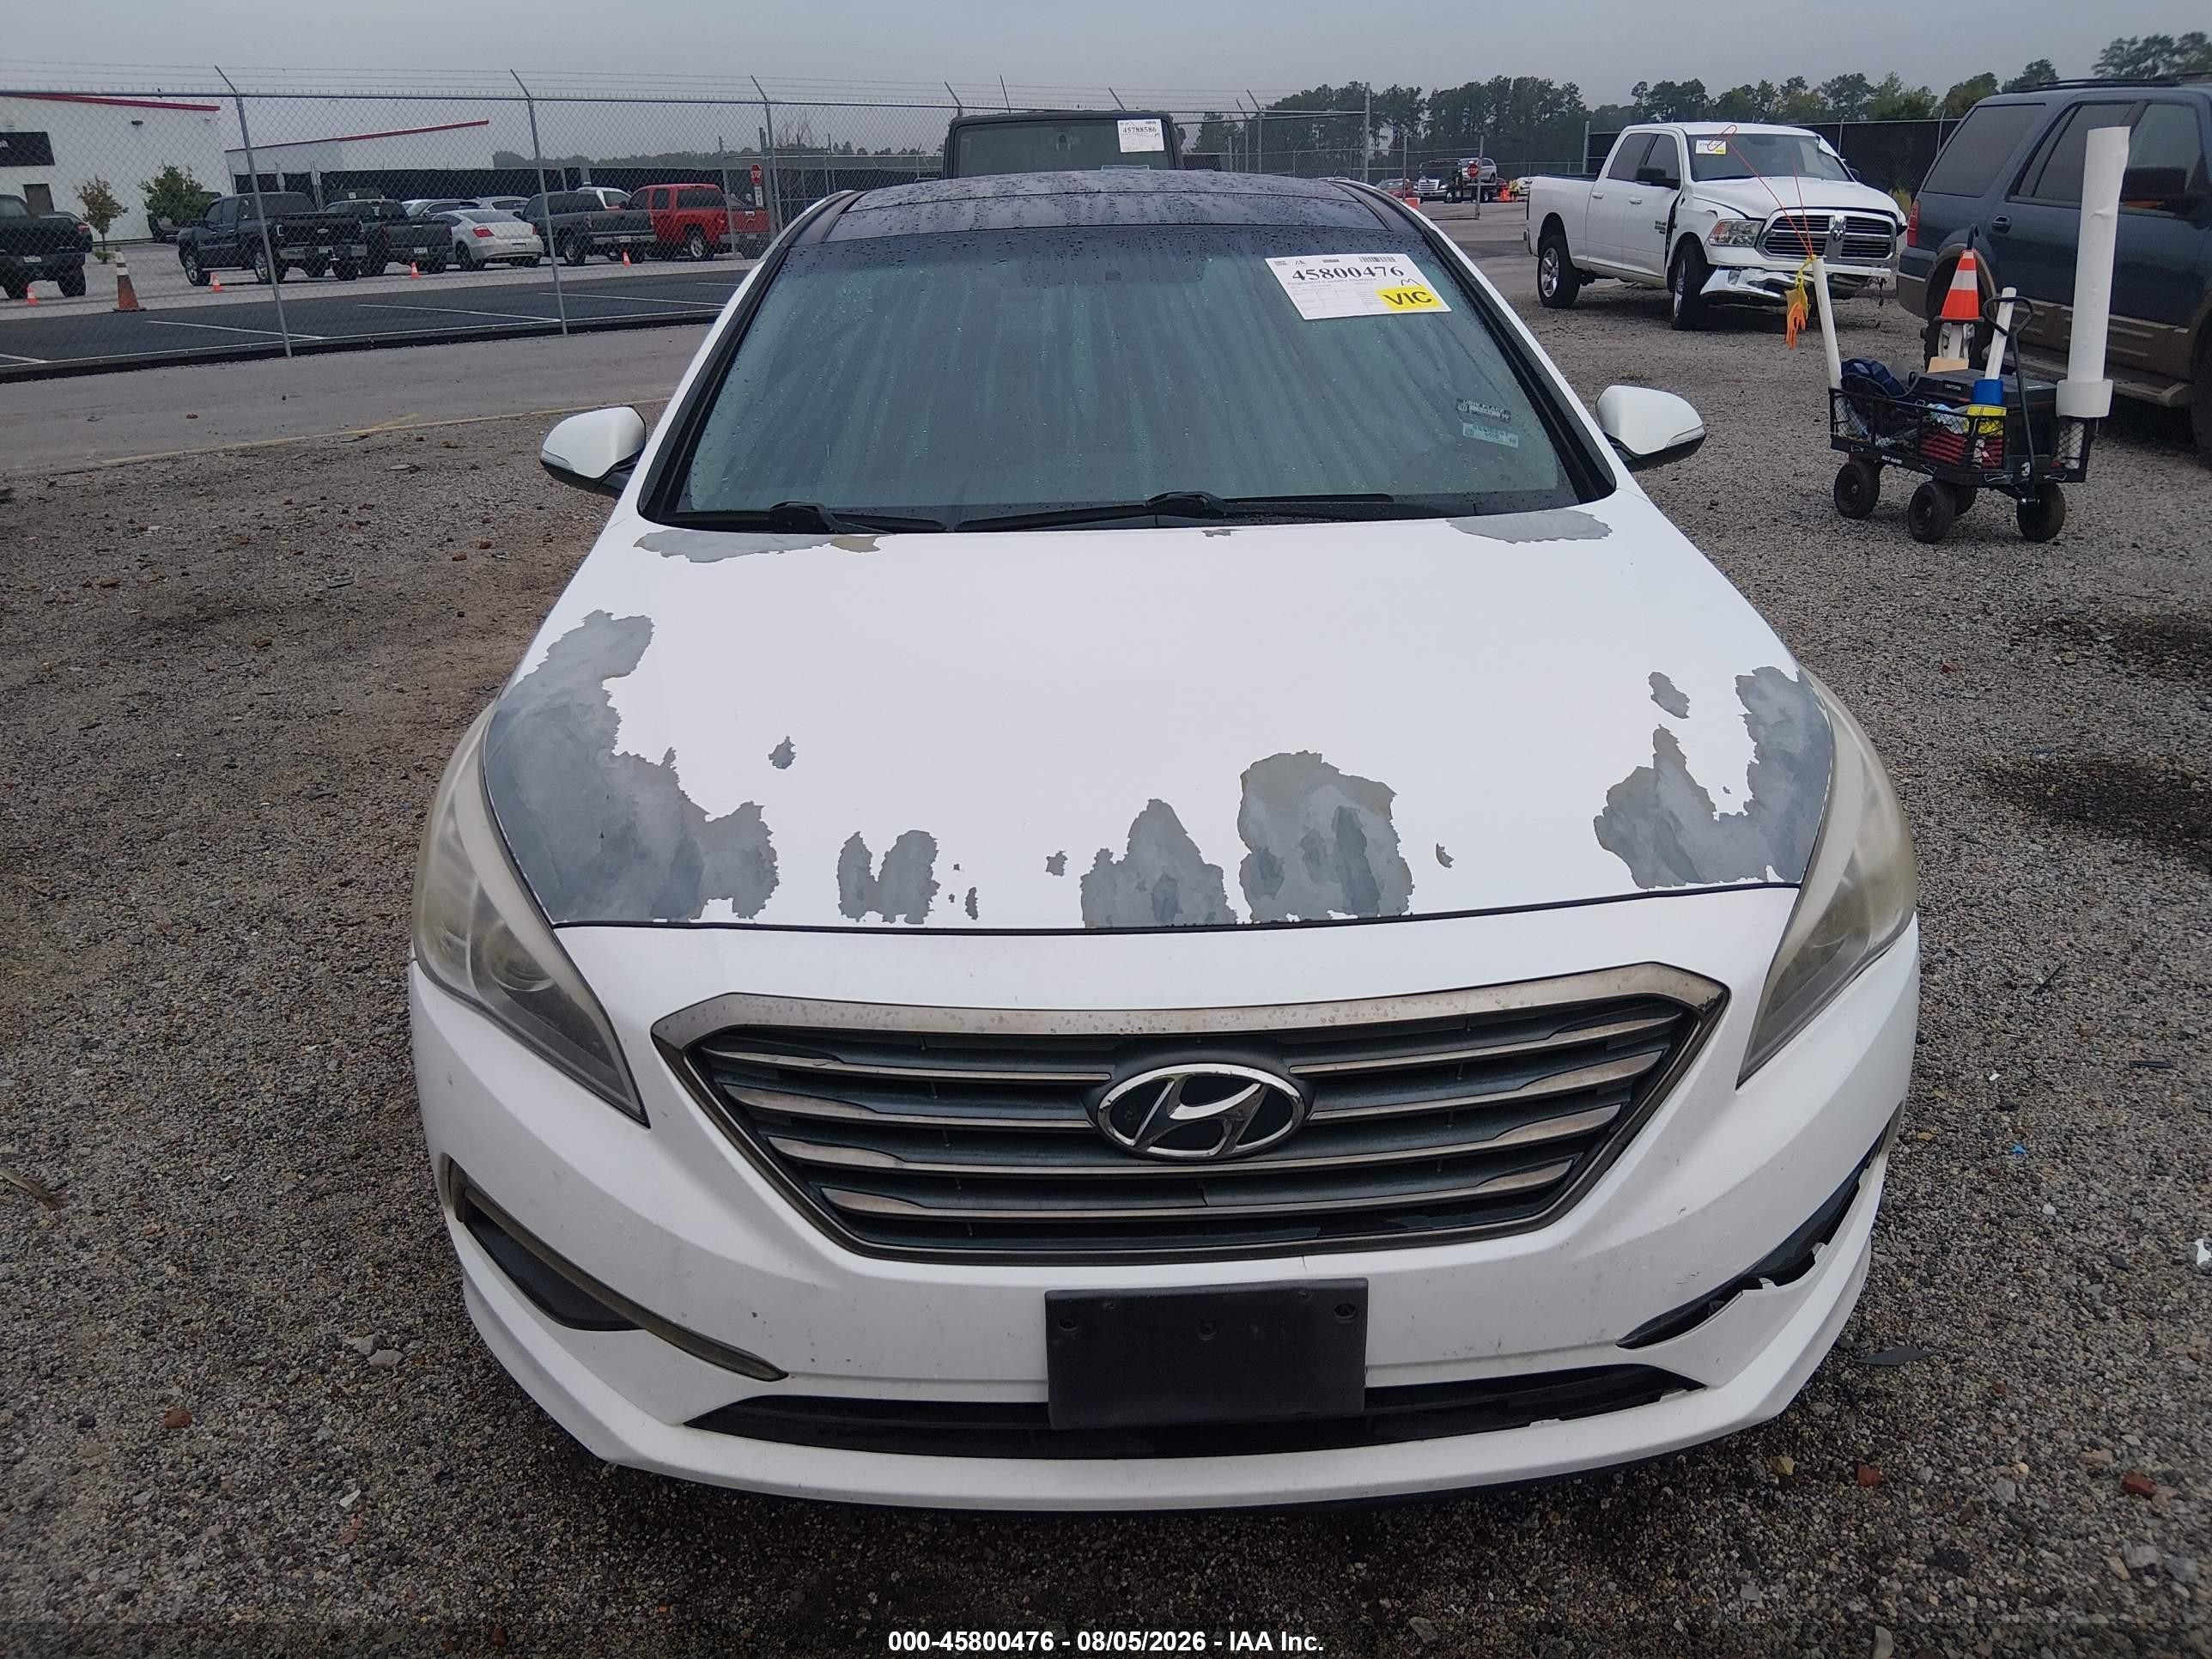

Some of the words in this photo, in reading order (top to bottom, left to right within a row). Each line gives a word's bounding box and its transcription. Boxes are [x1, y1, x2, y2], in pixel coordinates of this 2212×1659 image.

[750, 170, 763, 179] STOP
[1291, 265, 1405, 281] 45800476
[1382, 290, 1432, 305] VIC
